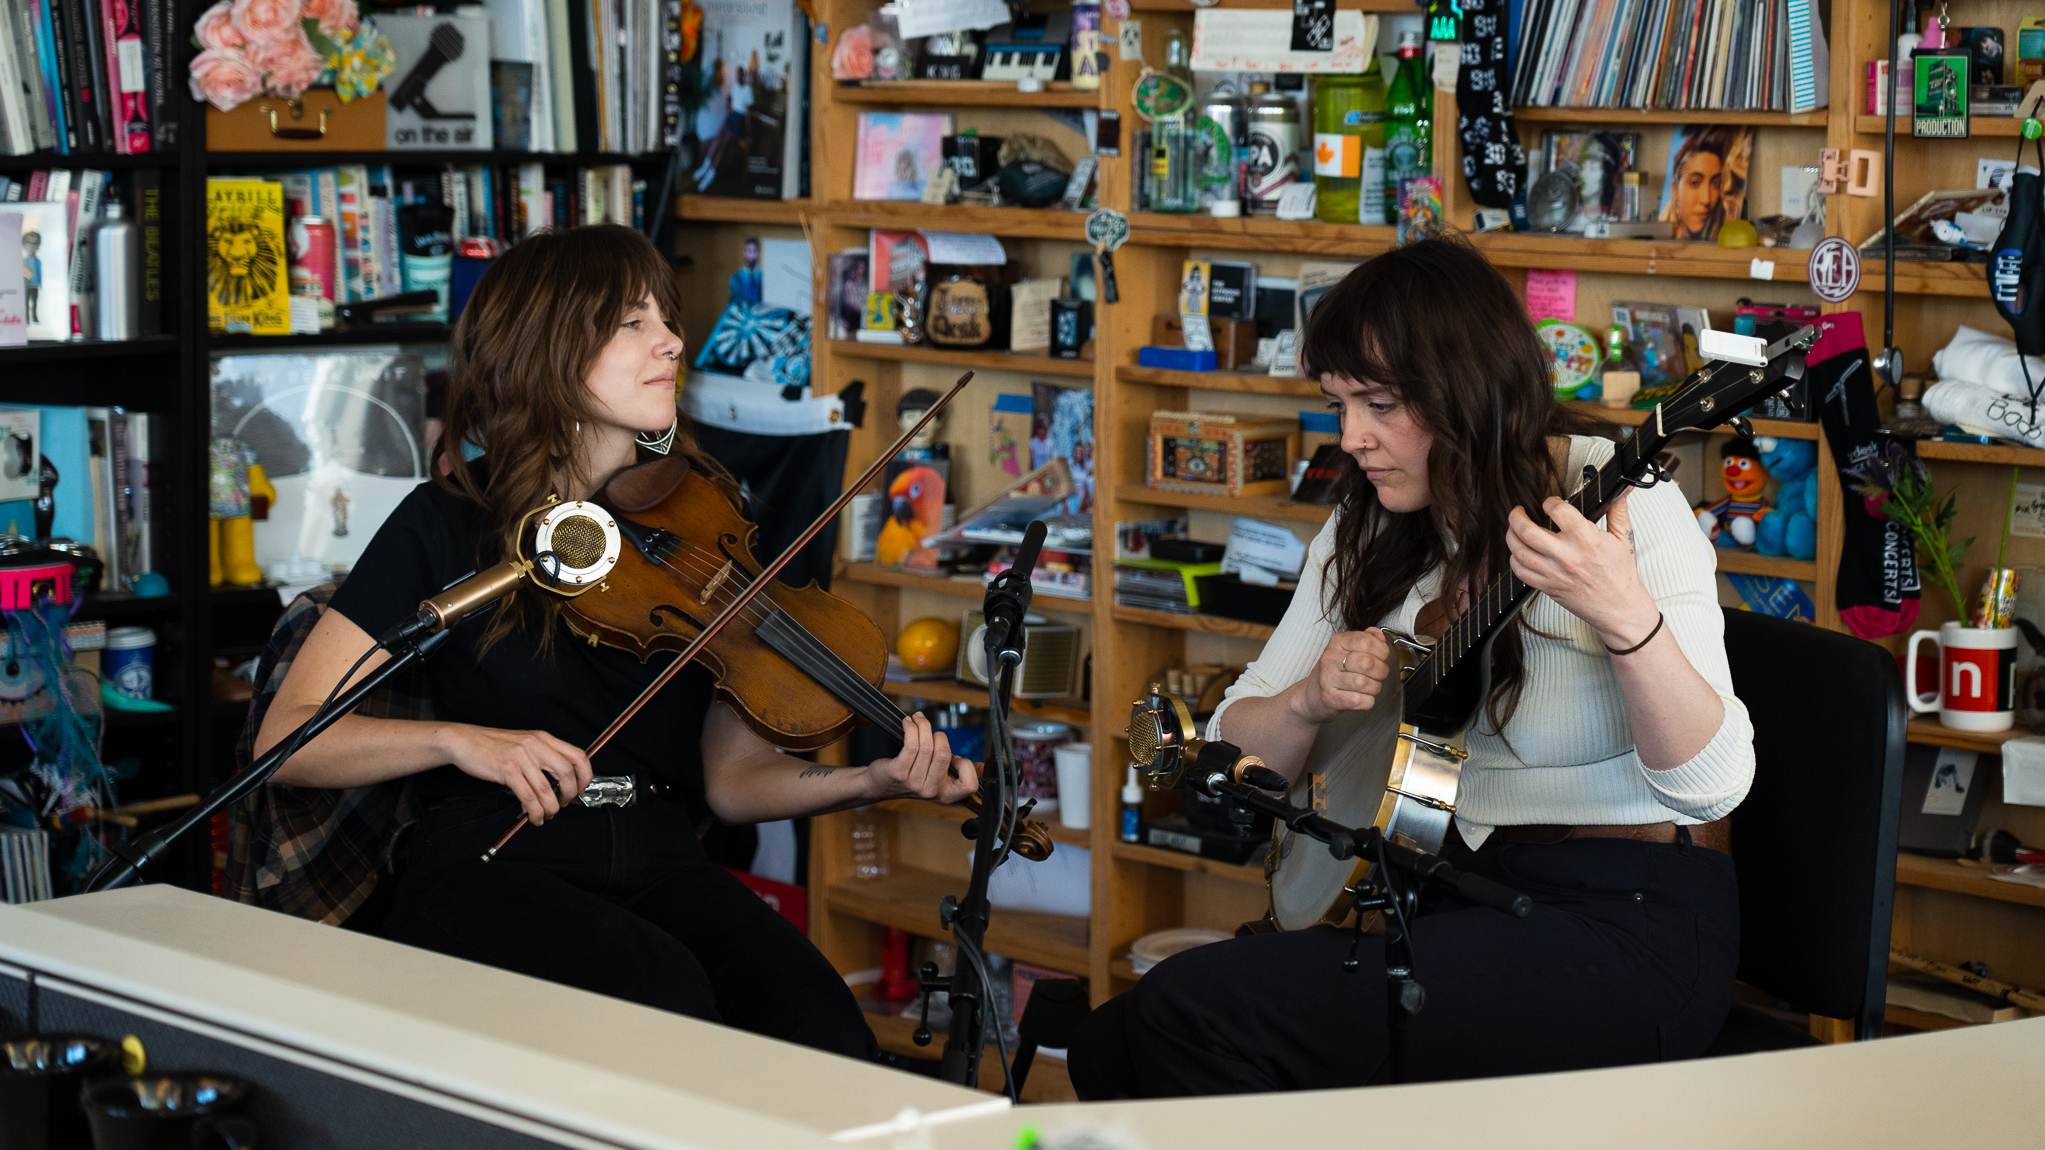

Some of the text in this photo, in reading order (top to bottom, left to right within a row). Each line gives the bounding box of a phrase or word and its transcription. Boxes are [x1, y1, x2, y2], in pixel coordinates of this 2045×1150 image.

[395, 120, 475, 144] on the air
[1916, 119, 1965, 136] PRODUCTION
[1883, 519, 1901, 600] CONCERTS
